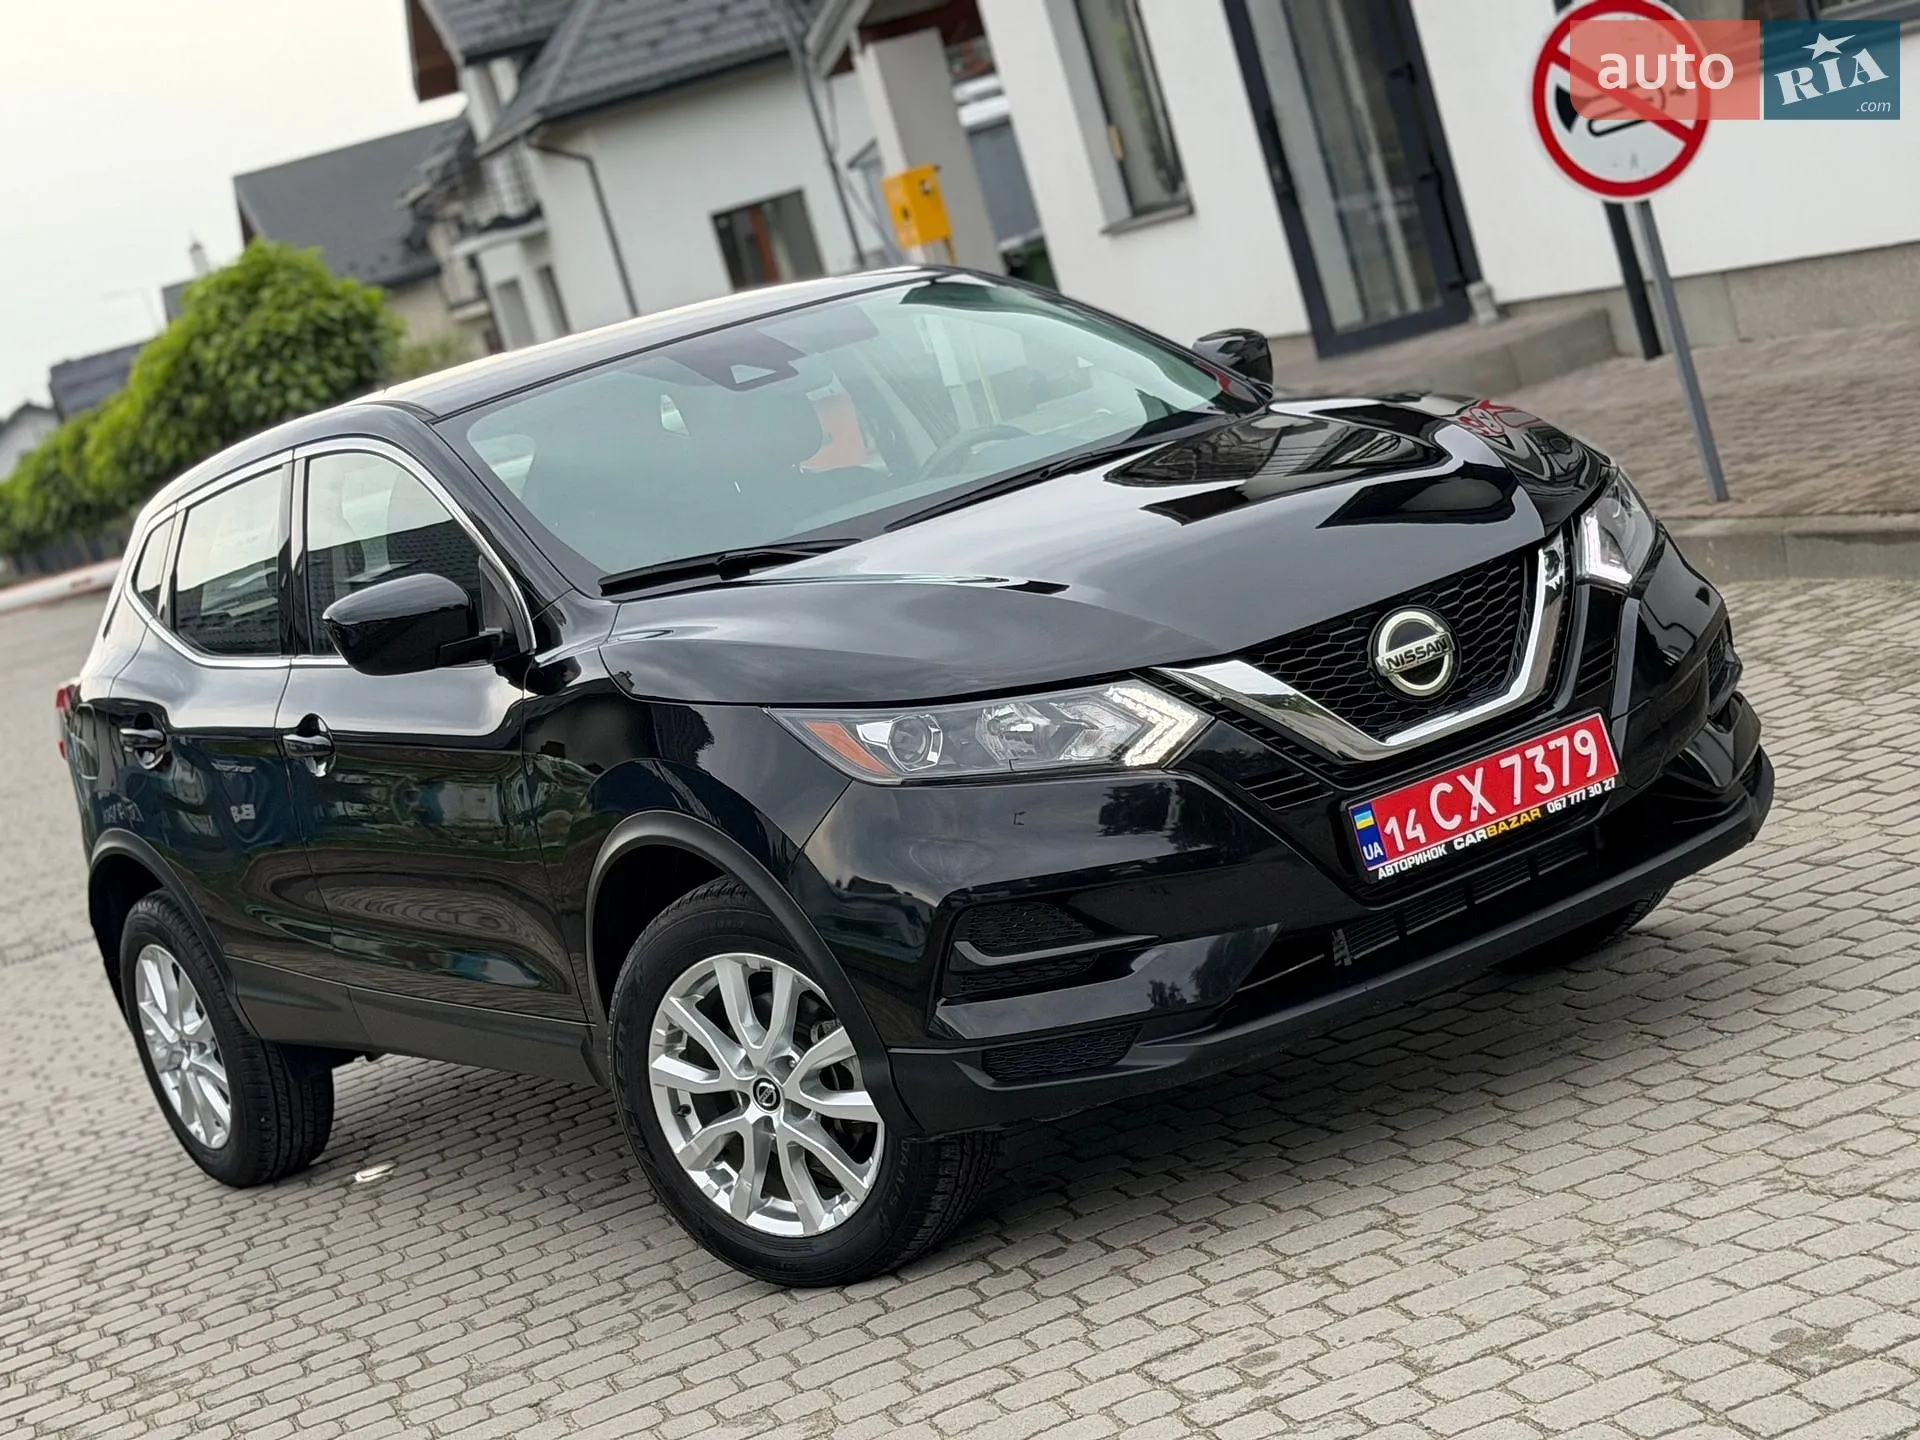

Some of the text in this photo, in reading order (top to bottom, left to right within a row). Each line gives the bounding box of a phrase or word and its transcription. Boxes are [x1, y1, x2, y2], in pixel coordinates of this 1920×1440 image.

[1385, 637, 1448, 670] NISSAN
[1384, 729, 1598, 851] 14 CX 7379
[1362, 841, 1384, 861] UA
[1378, 844, 1447, 880] АВТОРИНОК
[1453, 808, 1542, 851] CARBAZAR
[1547, 799, 1566, 814] 067
[1568, 790, 1586, 805] 777
[1587, 784, 1602, 798] 30
